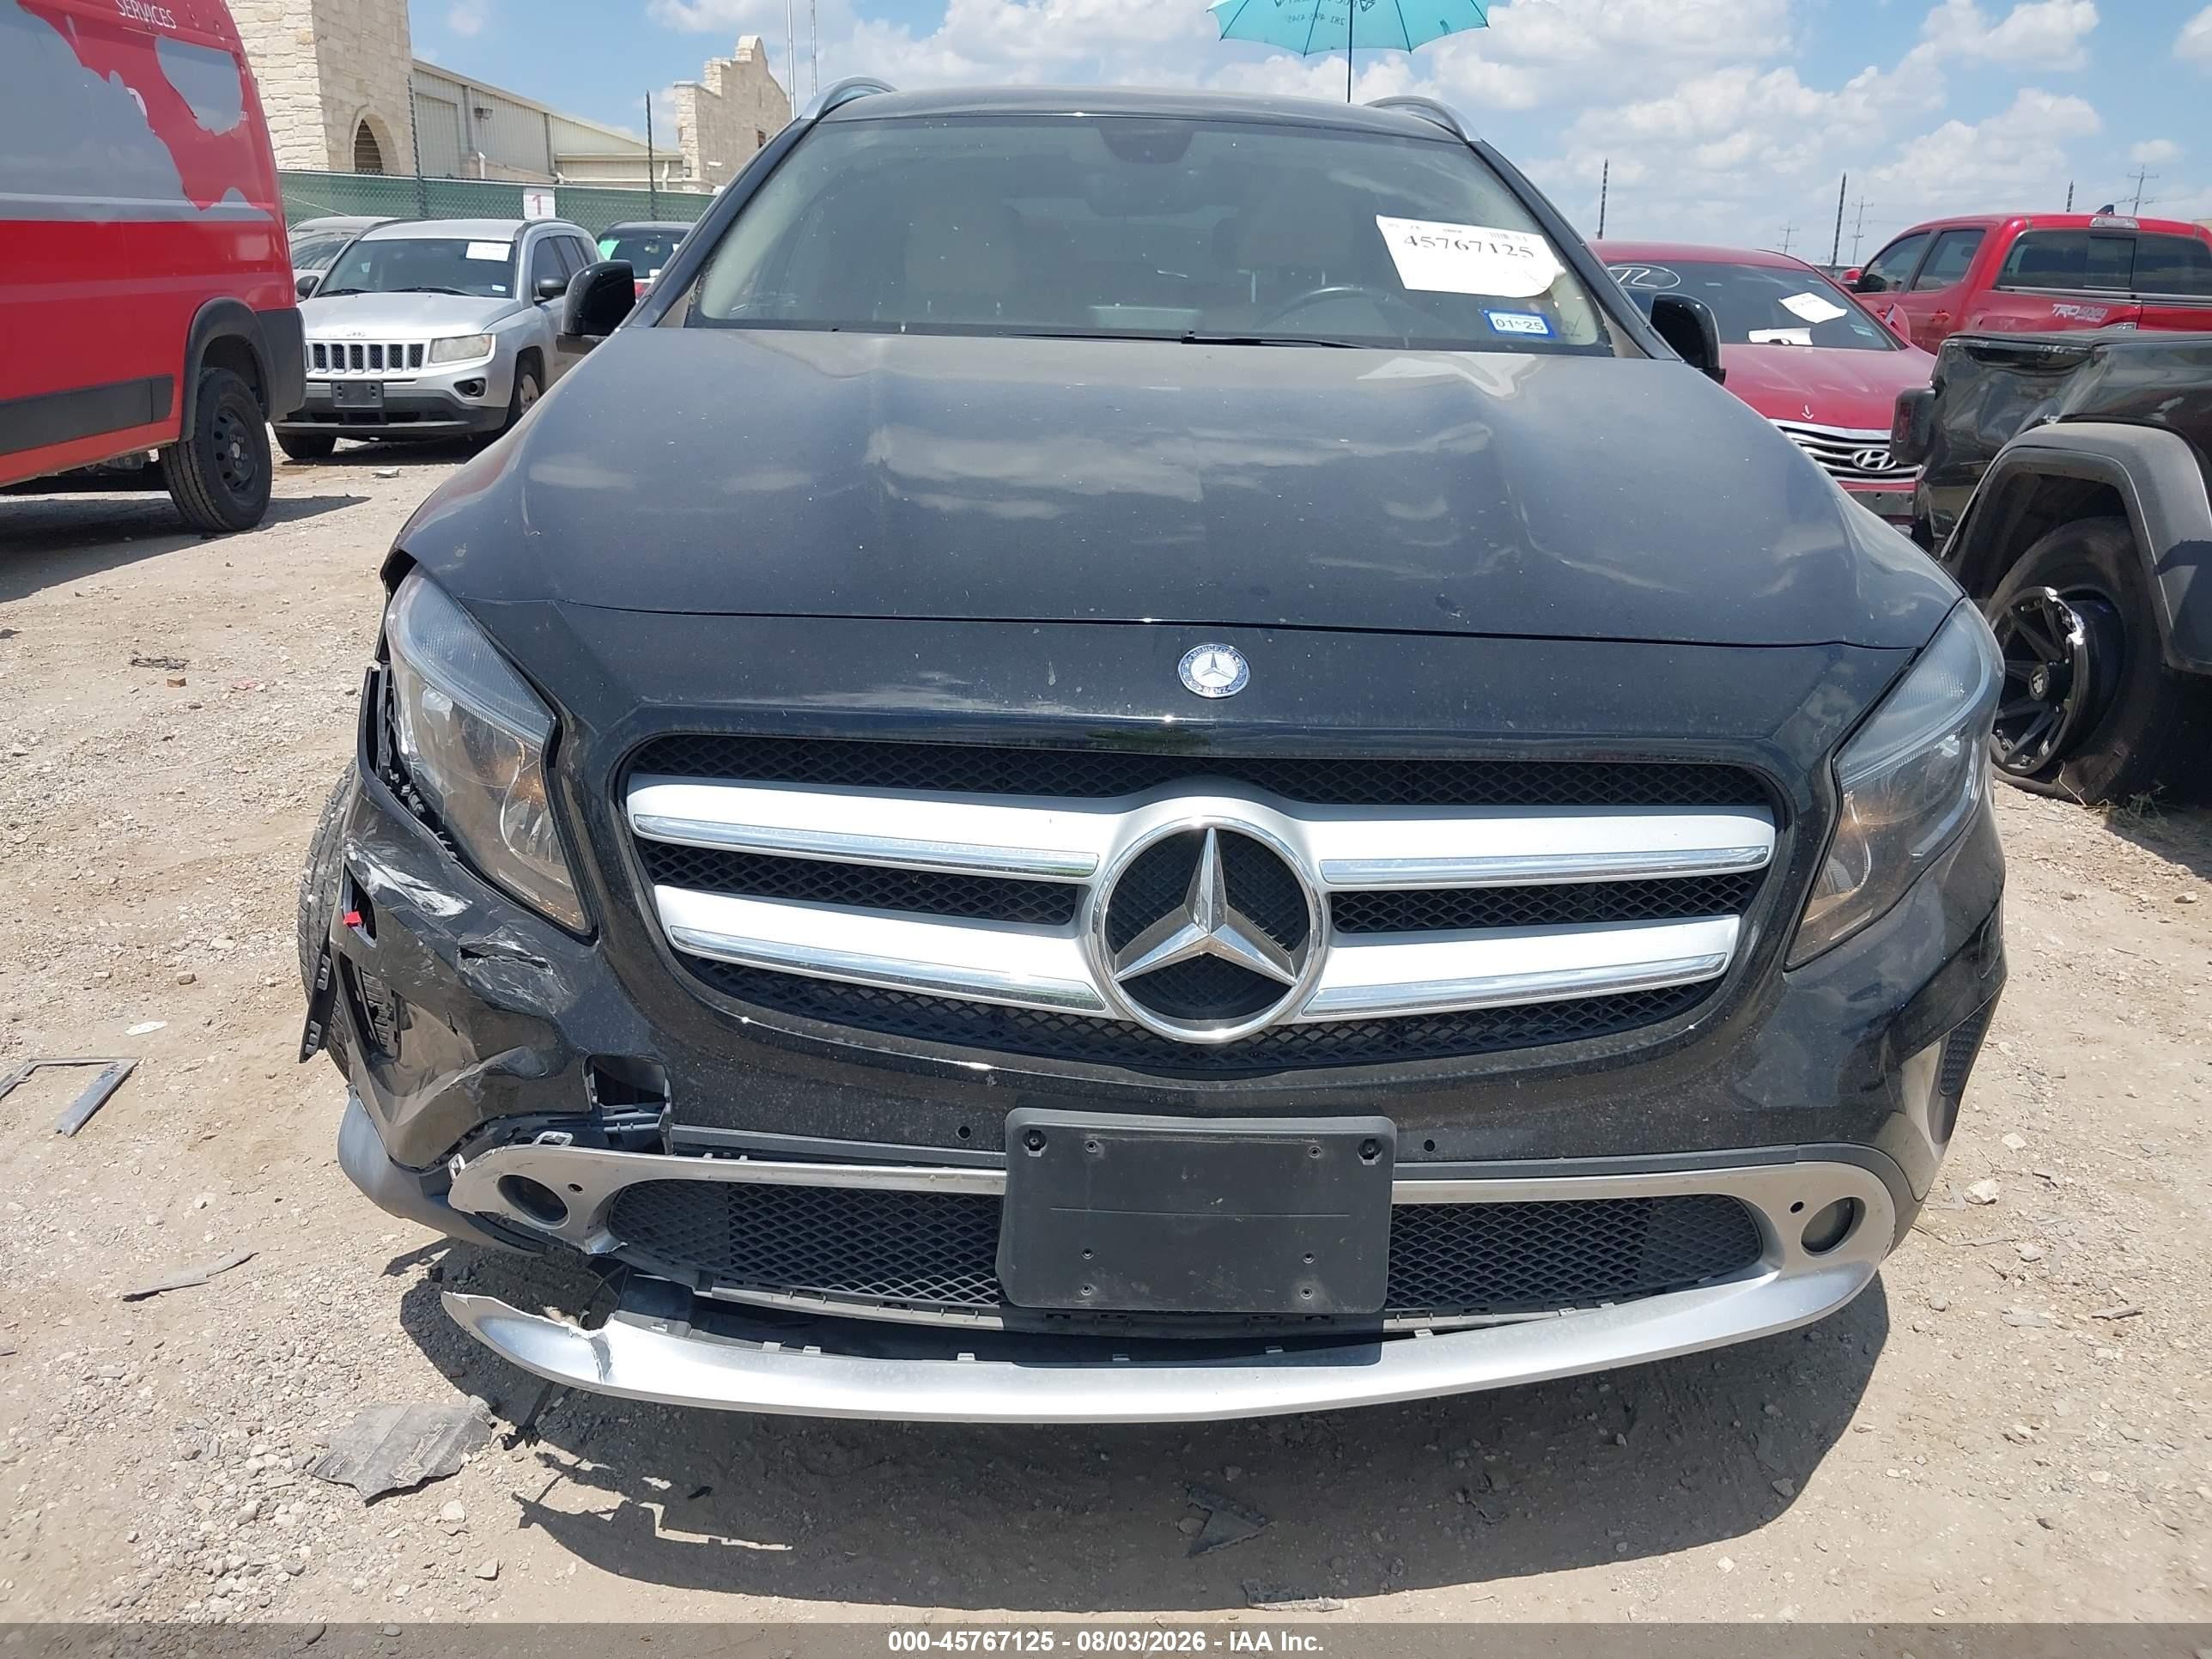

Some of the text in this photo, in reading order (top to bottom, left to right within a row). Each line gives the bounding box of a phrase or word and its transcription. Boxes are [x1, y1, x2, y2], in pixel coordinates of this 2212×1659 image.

[115, 0, 177, 29] SERVICES
[532, 194, 542, 216] 1
[1404, 234, 1534, 258] 45767125
[2051, 303, 2081, 319] TRD
[1496, 319, 1514, 328] 01
[1523, 320, 1544, 331] 25
